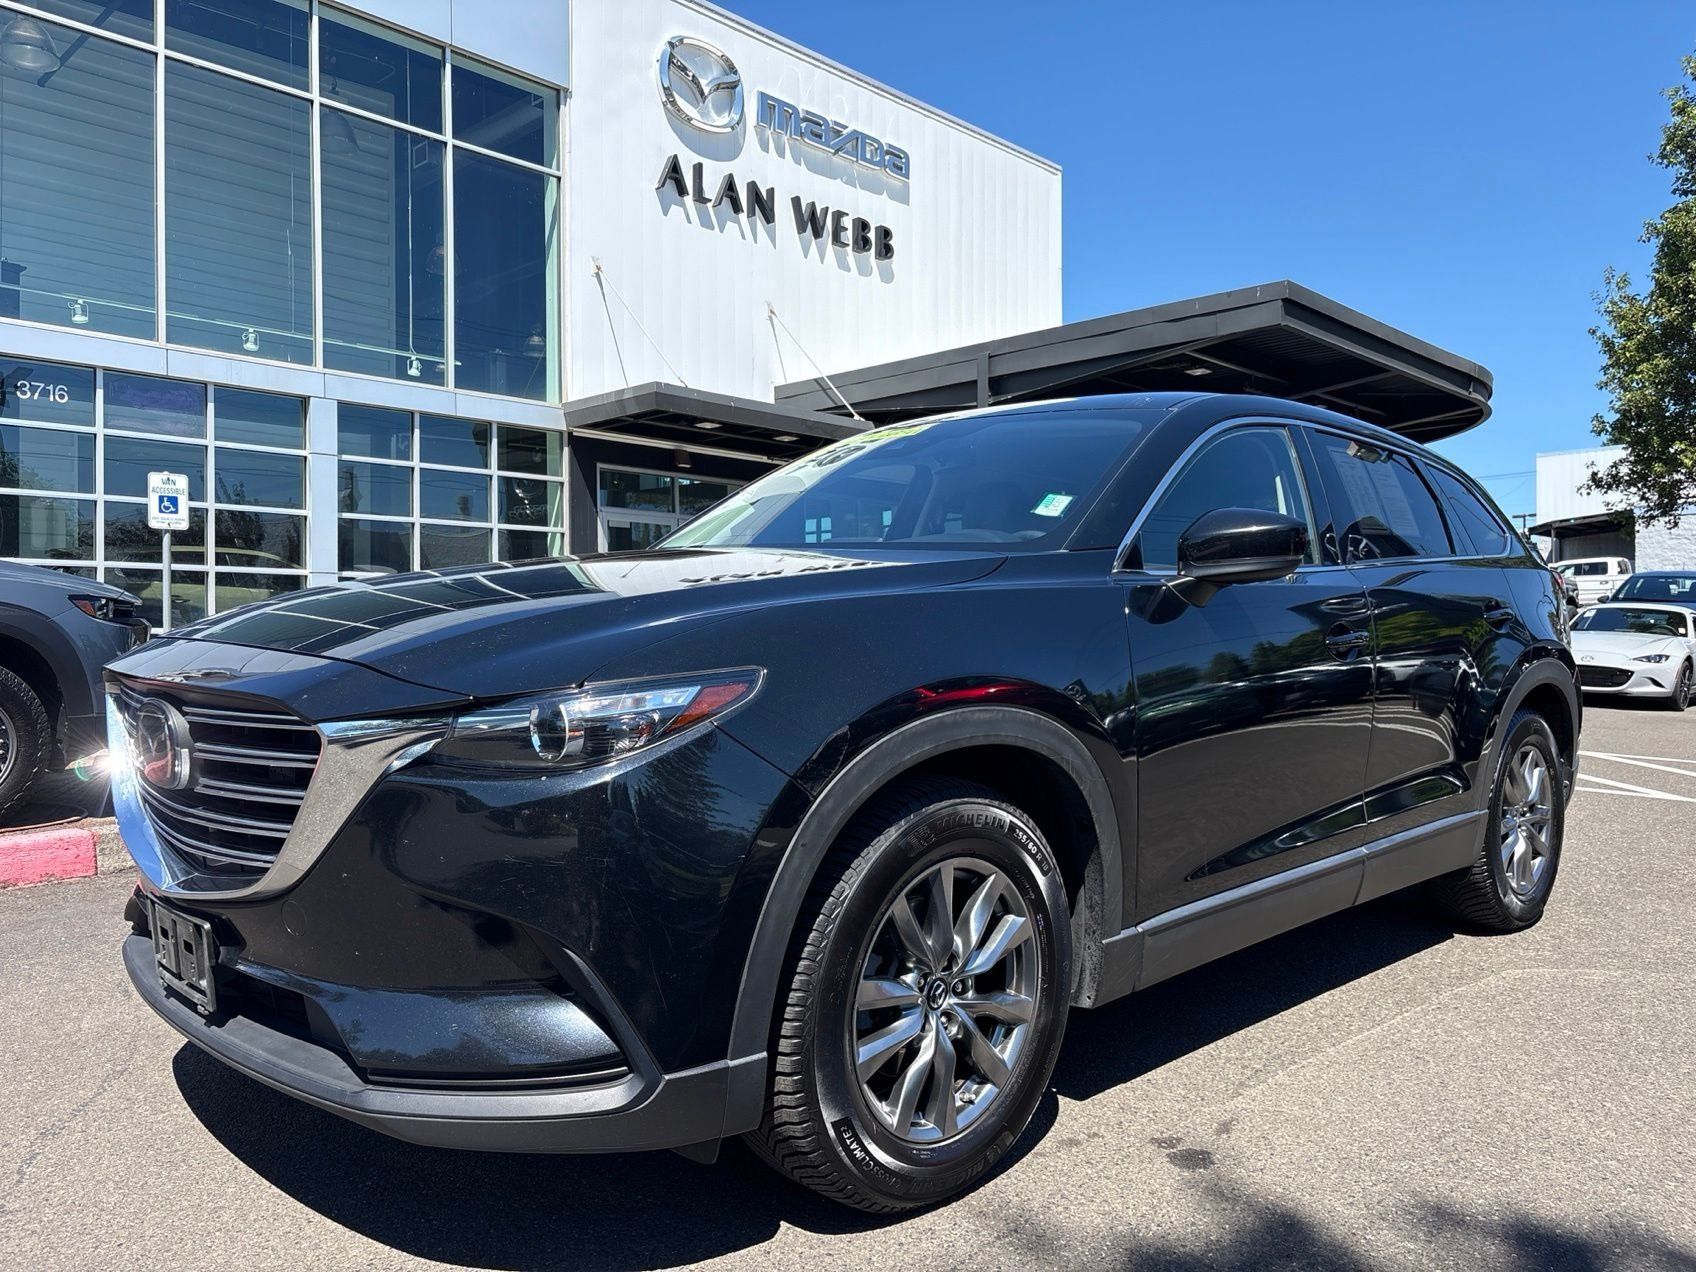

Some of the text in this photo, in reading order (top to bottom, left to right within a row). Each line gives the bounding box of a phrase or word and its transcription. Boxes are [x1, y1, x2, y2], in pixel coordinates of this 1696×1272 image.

[655, 154, 894, 261] ALAN WEBB
[16, 380, 68, 403] 3716
[161, 477, 176, 486] VAN
[151, 486, 186, 496] ACCESSIBLE
